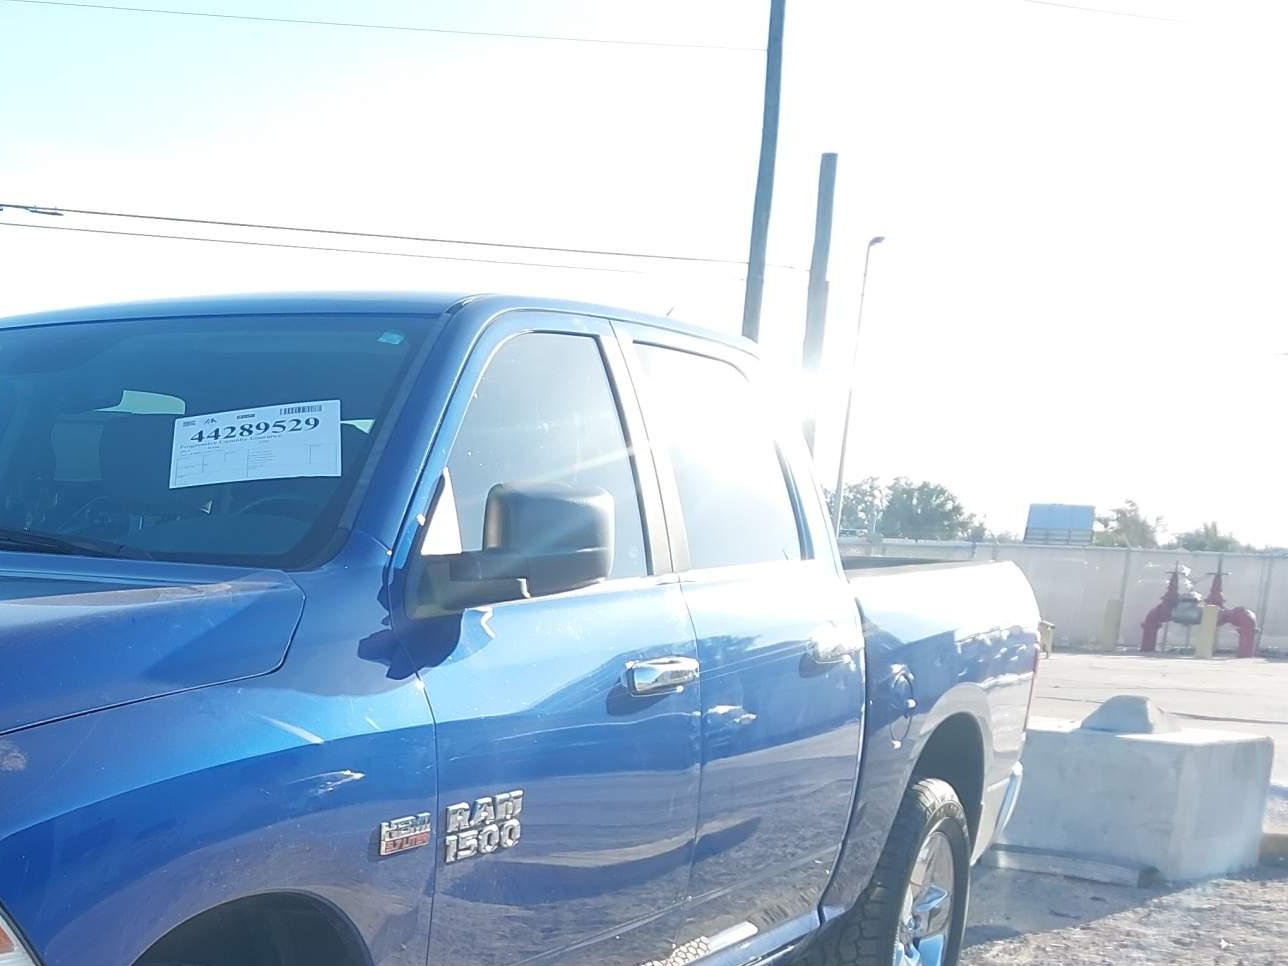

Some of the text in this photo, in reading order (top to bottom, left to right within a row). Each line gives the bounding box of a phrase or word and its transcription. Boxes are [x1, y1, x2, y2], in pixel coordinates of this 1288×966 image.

[190, 417, 320, 443] 44289529
[381, 812, 431, 841] HEMI
[446, 789, 524, 833] RAM
[445, 818, 521, 864] 1500
